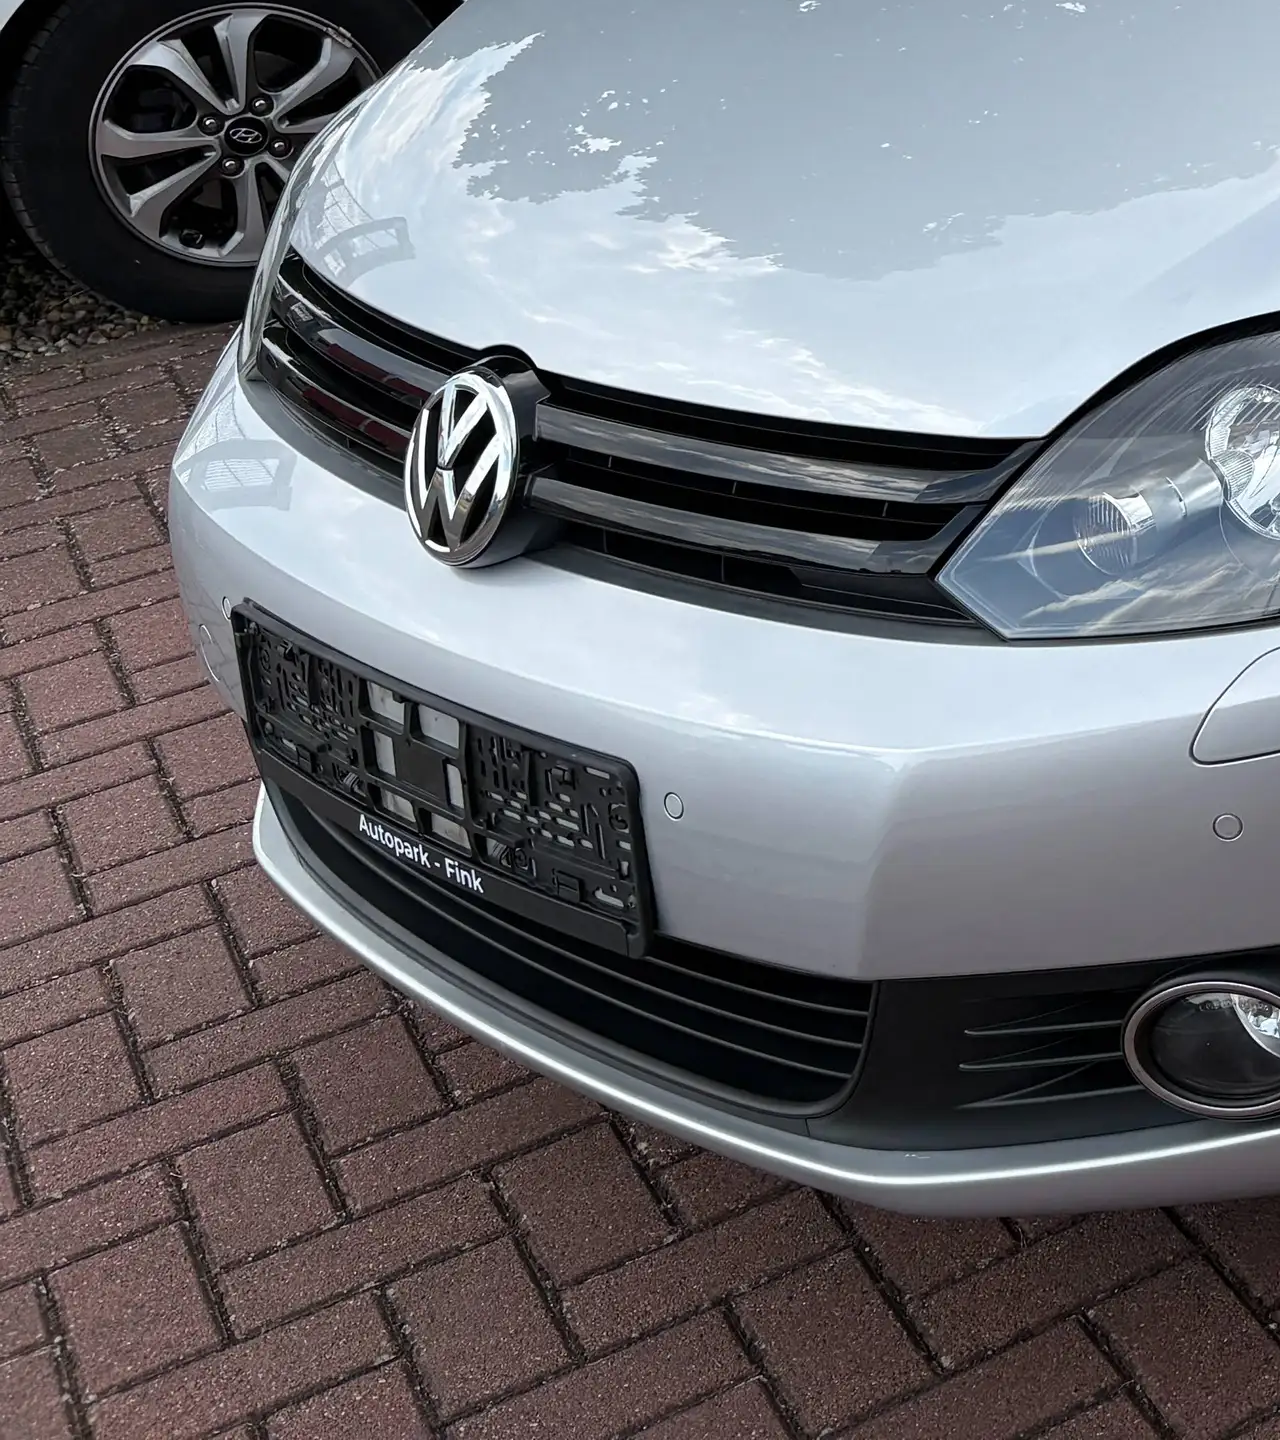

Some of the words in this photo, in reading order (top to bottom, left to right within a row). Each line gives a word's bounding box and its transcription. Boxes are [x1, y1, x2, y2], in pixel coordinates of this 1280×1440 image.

[410, 372, 514, 560] VW
[359, 813, 431, 869] Autopark
[444, 857, 484, 894] Fink
